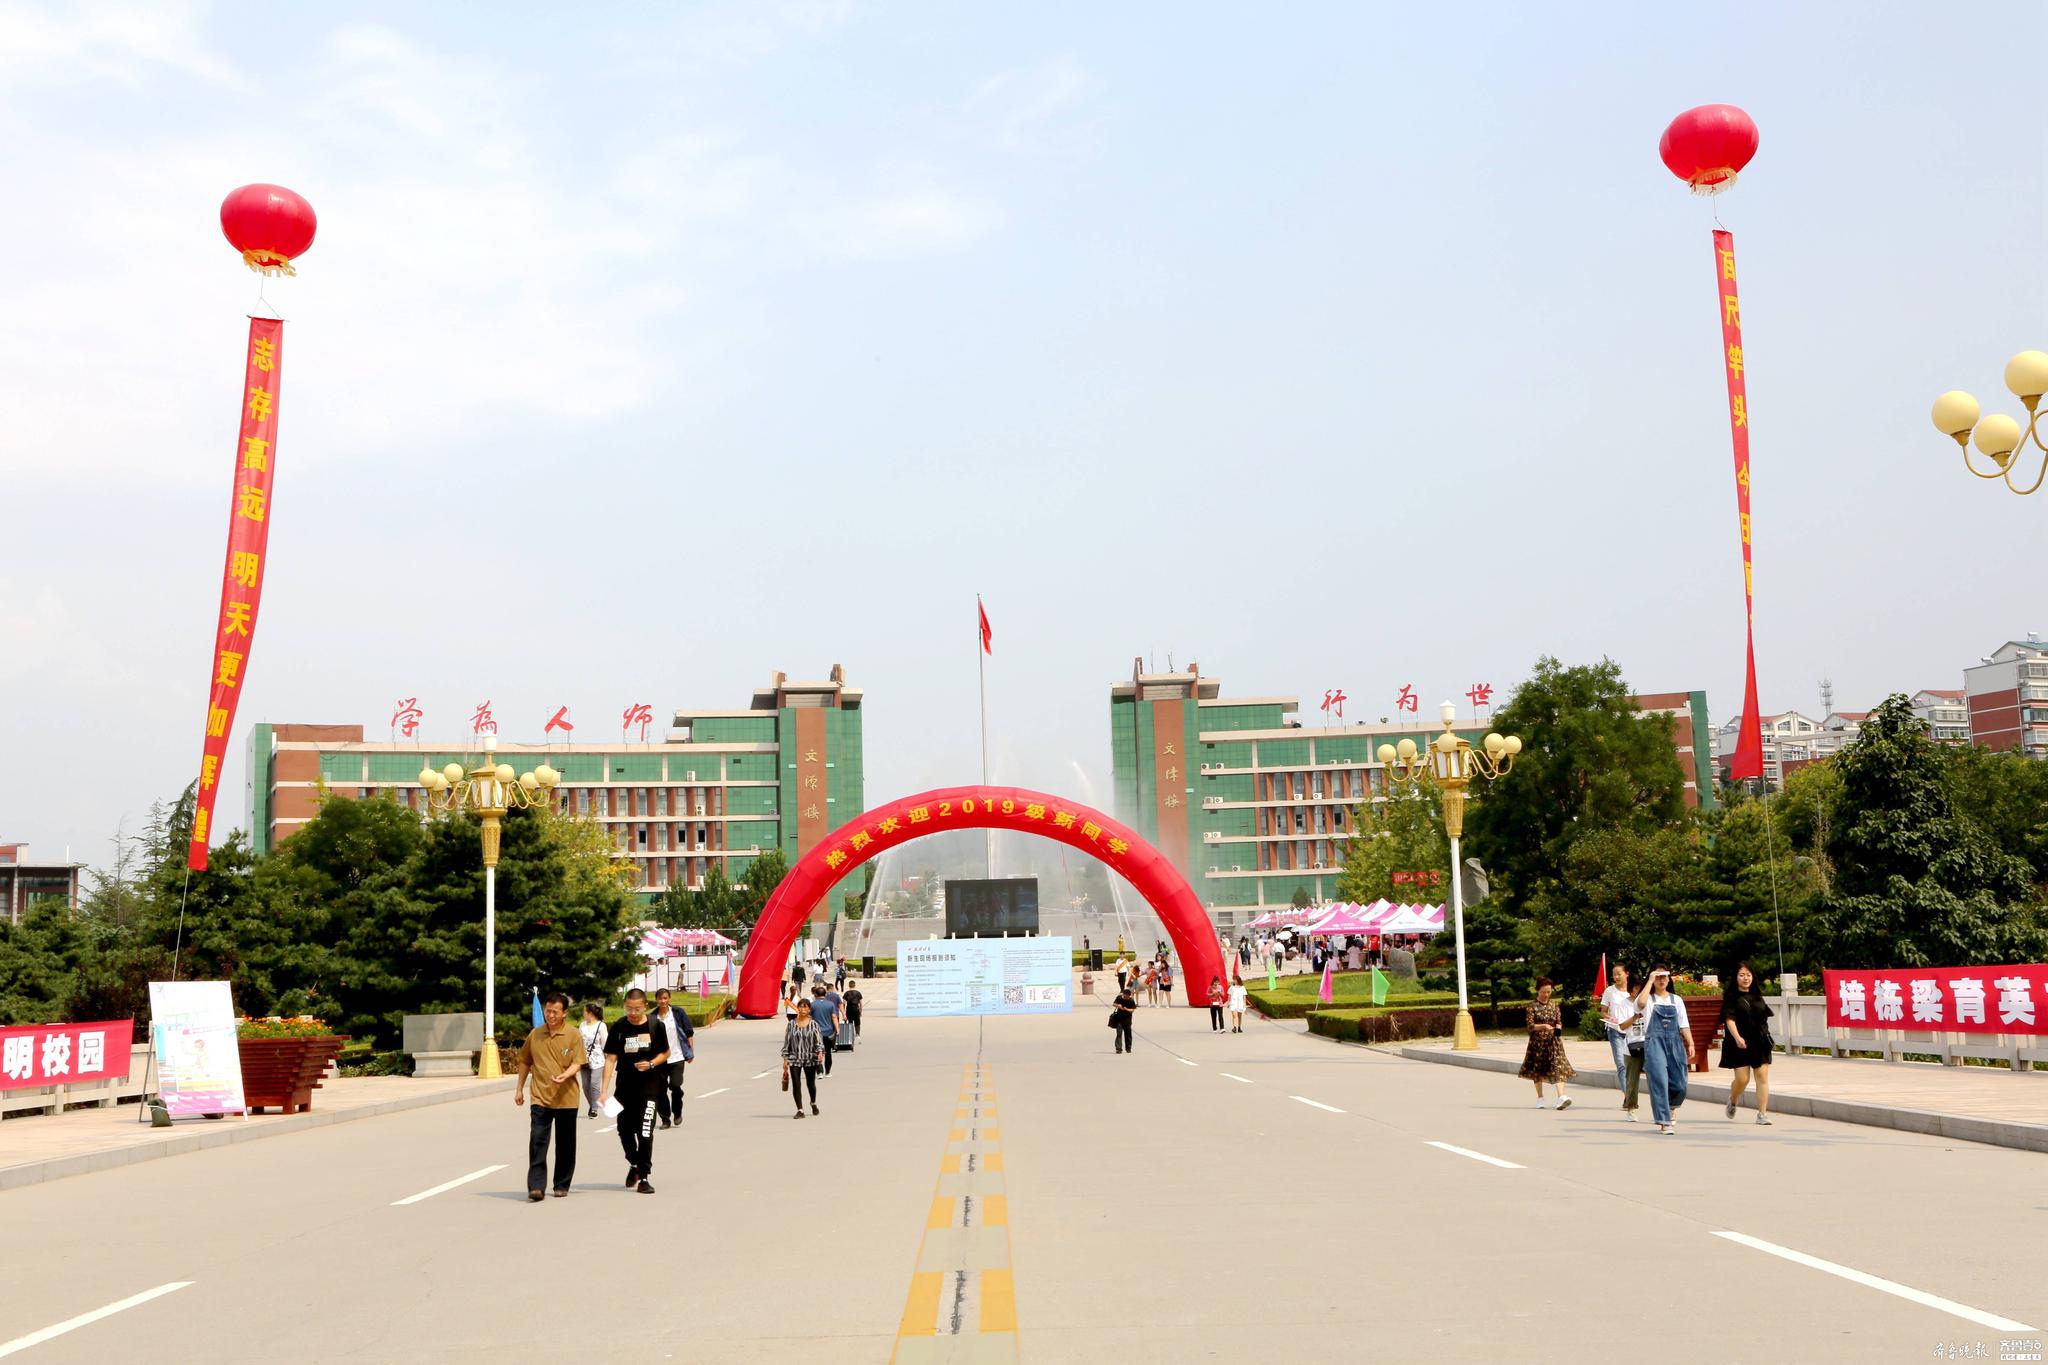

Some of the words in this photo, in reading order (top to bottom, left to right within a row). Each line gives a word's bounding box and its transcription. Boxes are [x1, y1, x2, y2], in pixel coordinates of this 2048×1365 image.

[237, 337, 275, 522] 志存高远
[825, 799, 1129, 869] 热烈欢迎2019级新同学
[1839, 977, 2048, 1026] 培栋梁育英
[2, 1031, 105, 1080] 明校园
